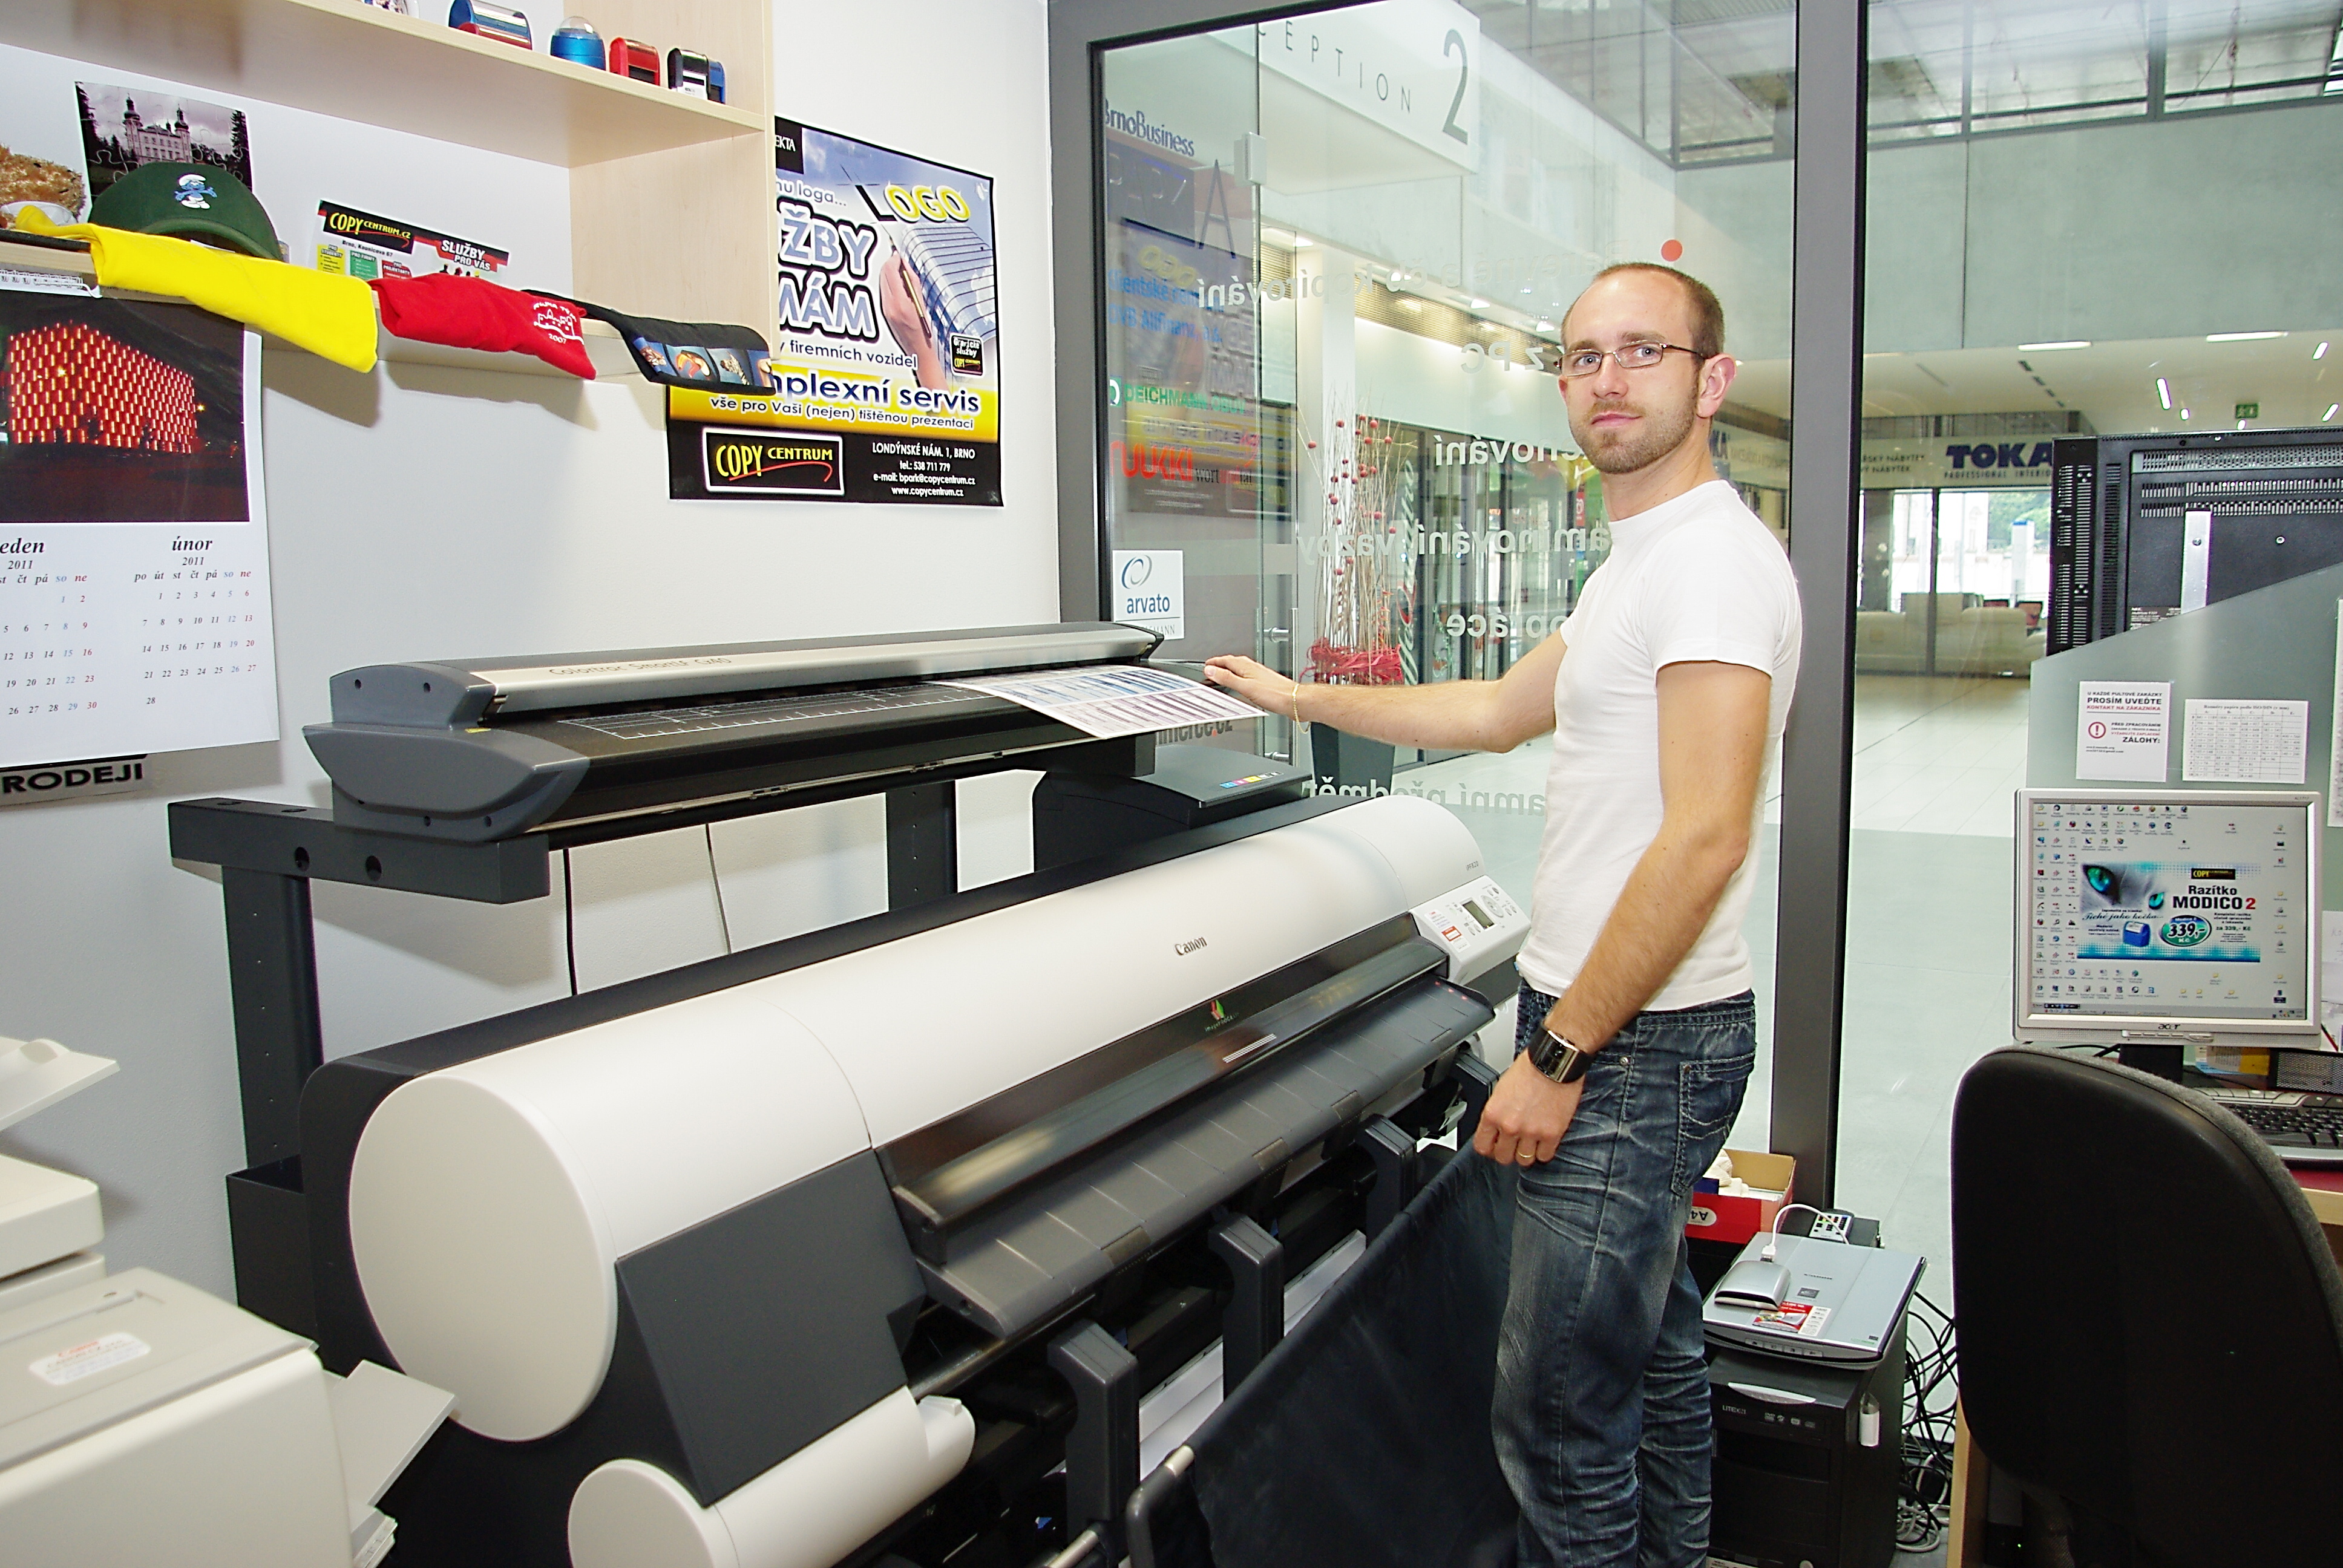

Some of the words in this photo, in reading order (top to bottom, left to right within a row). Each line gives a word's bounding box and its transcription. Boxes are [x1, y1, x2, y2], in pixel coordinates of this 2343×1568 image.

[1257, 21, 1411, 114] EPTION
[1441, 28, 1469, 146] 2
[775, 134, 796, 152] EKTA
[854, 181, 971, 223] LOGO
[329, 212, 364, 235] COPY
[363, 220, 411, 239] CENTRUM.CZ
[780, 204, 875, 276] ŽBY
[441, 240, 487, 260] SLUŽBY
[454, 255, 473, 267] PRO
[474, 259, 491, 271] VÁS
[548, 333, 567, 344] 2007
[789, 339, 862, 362] firemních
[867, 352, 918, 368] vozidel
[900, 388, 980, 413] servis
[1123, 384, 1208, 411] DEICHMANN
[710, 396, 737, 409] vše
[742, 402, 767, 412] pro
[772, 402, 802, 414] Vaši
[806, 404, 856, 422] (nejen)
[859, 409, 908, 424] tištěnou
[911, 416, 974, 430] prezentaci
[872, 440, 921, 456] LONDÝNSKÉ
[922, 443, 944, 457] NÁM.
[945, 446, 953, 459] 1,
[954, 448, 976, 460] BRNO
[1945, 443, 2053, 469] TOKA
[716, 444, 764, 477] COPY
[767, 447, 833, 461] CENTRUM
[913, 462, 926, 471] 538
[926, 462, 938, 472] 711
[939, 463, 951, 472] 779
[873, 472, 899, 483] e-mail:
[899, 472, 976, 486] bpark@copycentrum.cz
[891, 487, 965, 497] www.copycentrum.cz
[0, 537, 44, 554] eden
[172, 535, 213, 551] únor
[7, 560, 33, 570] 2011
[182, 557, 204, 566] 2011
[17, 575, 27, 584] čt
[34, 573, 48, 586] pá
[134, 573, 147, 583] po
[154, 571, 164, 580] út
[190, 570, 199, 579] čt
[205, 569, 217, 581] pá
[1126, 593, 1171, 615] arvato
[44, 623, 50, 632] 7
[549, 665, 627, 676] Colortrac
[28, 705, 39, 714] 27
[87, 701, 97, 710] 30
[2122, 736, 2161, 744] ZÁLOHY:
[1, 763, 143, 793] RODEJI
[2187, 885, 2238, 895] Razítko
[2172, 896, 2243, 909] MODICO
[2245, 897, 2256, 910] 2
[2108, 912, 2131, 921] jako
[2168, 921, 2206, 938] 339,-
[1174, 936, 1208, 956] Canon
[1690, 1210, 1708, 1221] A4
